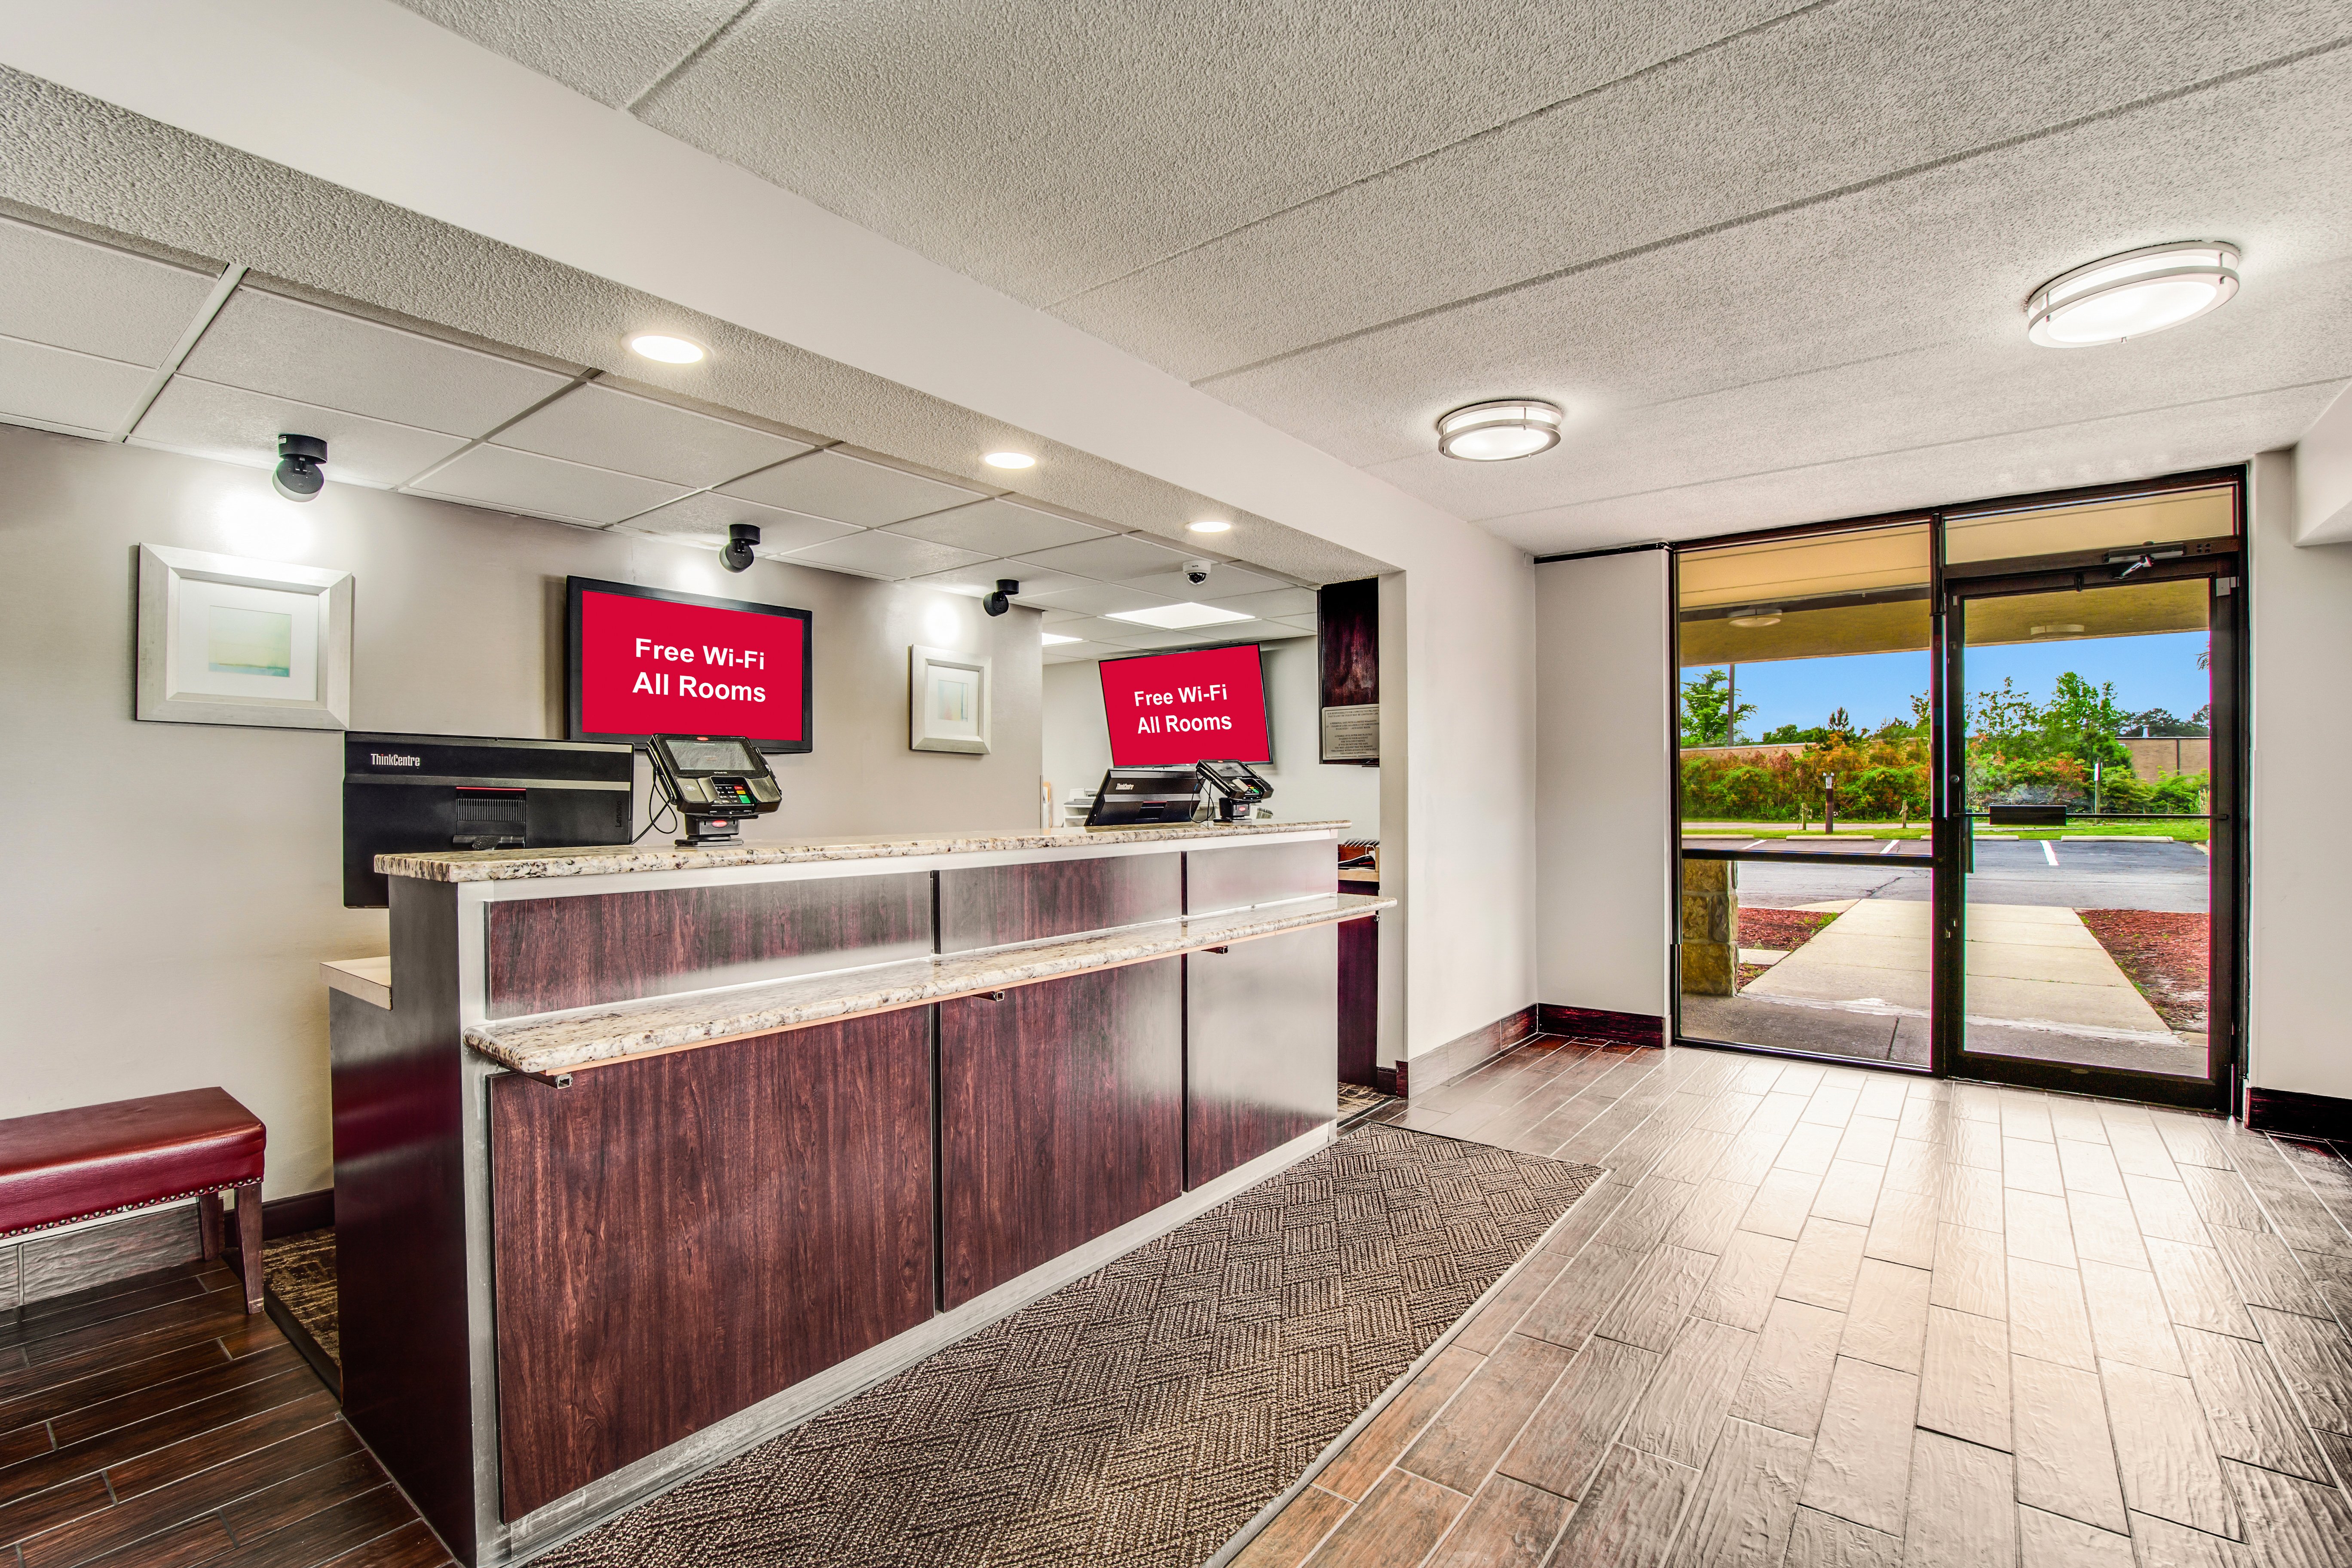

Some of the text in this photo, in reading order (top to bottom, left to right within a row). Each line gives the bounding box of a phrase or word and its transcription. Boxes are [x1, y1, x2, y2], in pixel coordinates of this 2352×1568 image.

[636, 638, 764, 670] Free Wi-Fi
[633, 672, 766, 702] All Rooms
[1134, 684, 1227, 706] Free Wi-Fi
[1138, 715, 1232, 734] All Rooms
[371, 753, 420, 766] ThinkCentre
